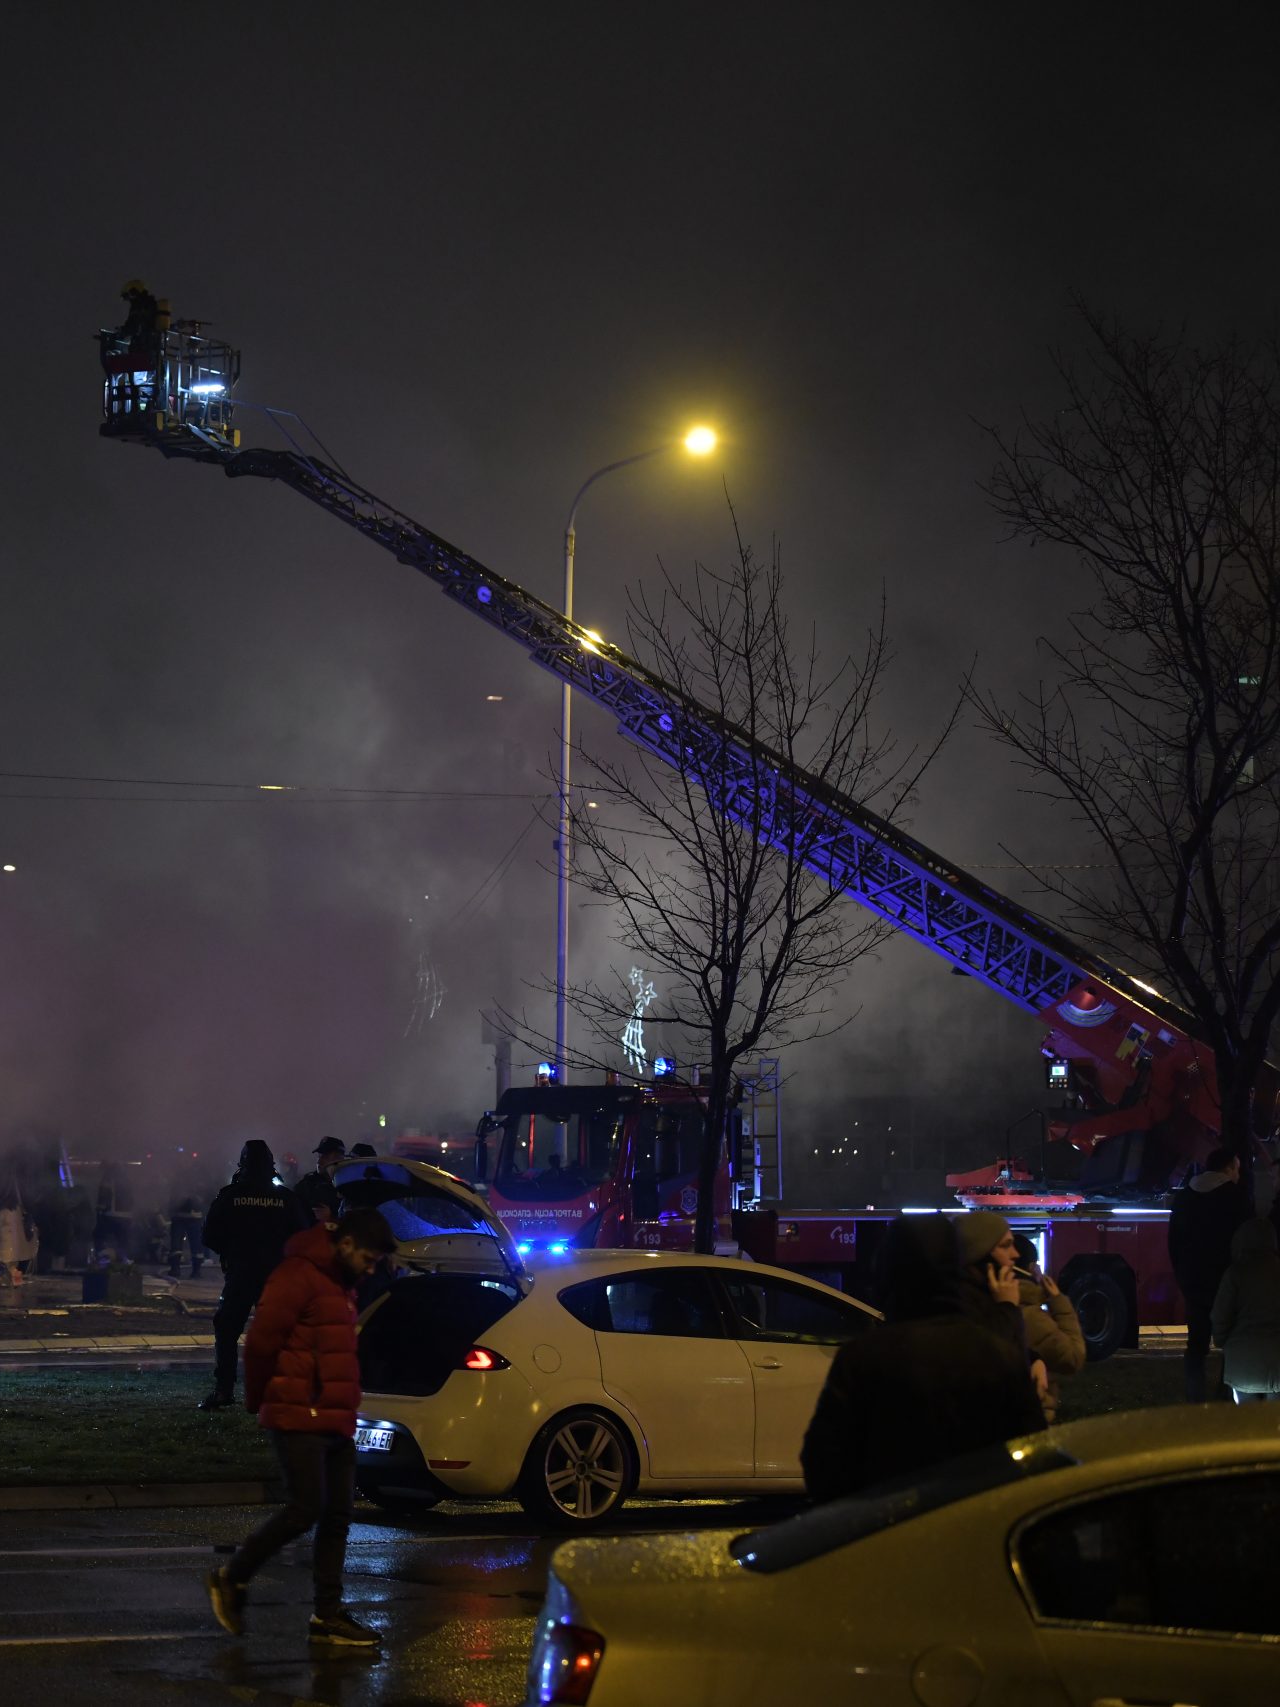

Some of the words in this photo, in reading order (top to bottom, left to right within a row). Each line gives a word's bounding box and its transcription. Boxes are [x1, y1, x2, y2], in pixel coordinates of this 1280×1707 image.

[233, 1196, 284, 1208] ПОЛИЦИЈА
[643, 1233, 661, 1245] 193
[839, 1233, 856, 1244] 193
